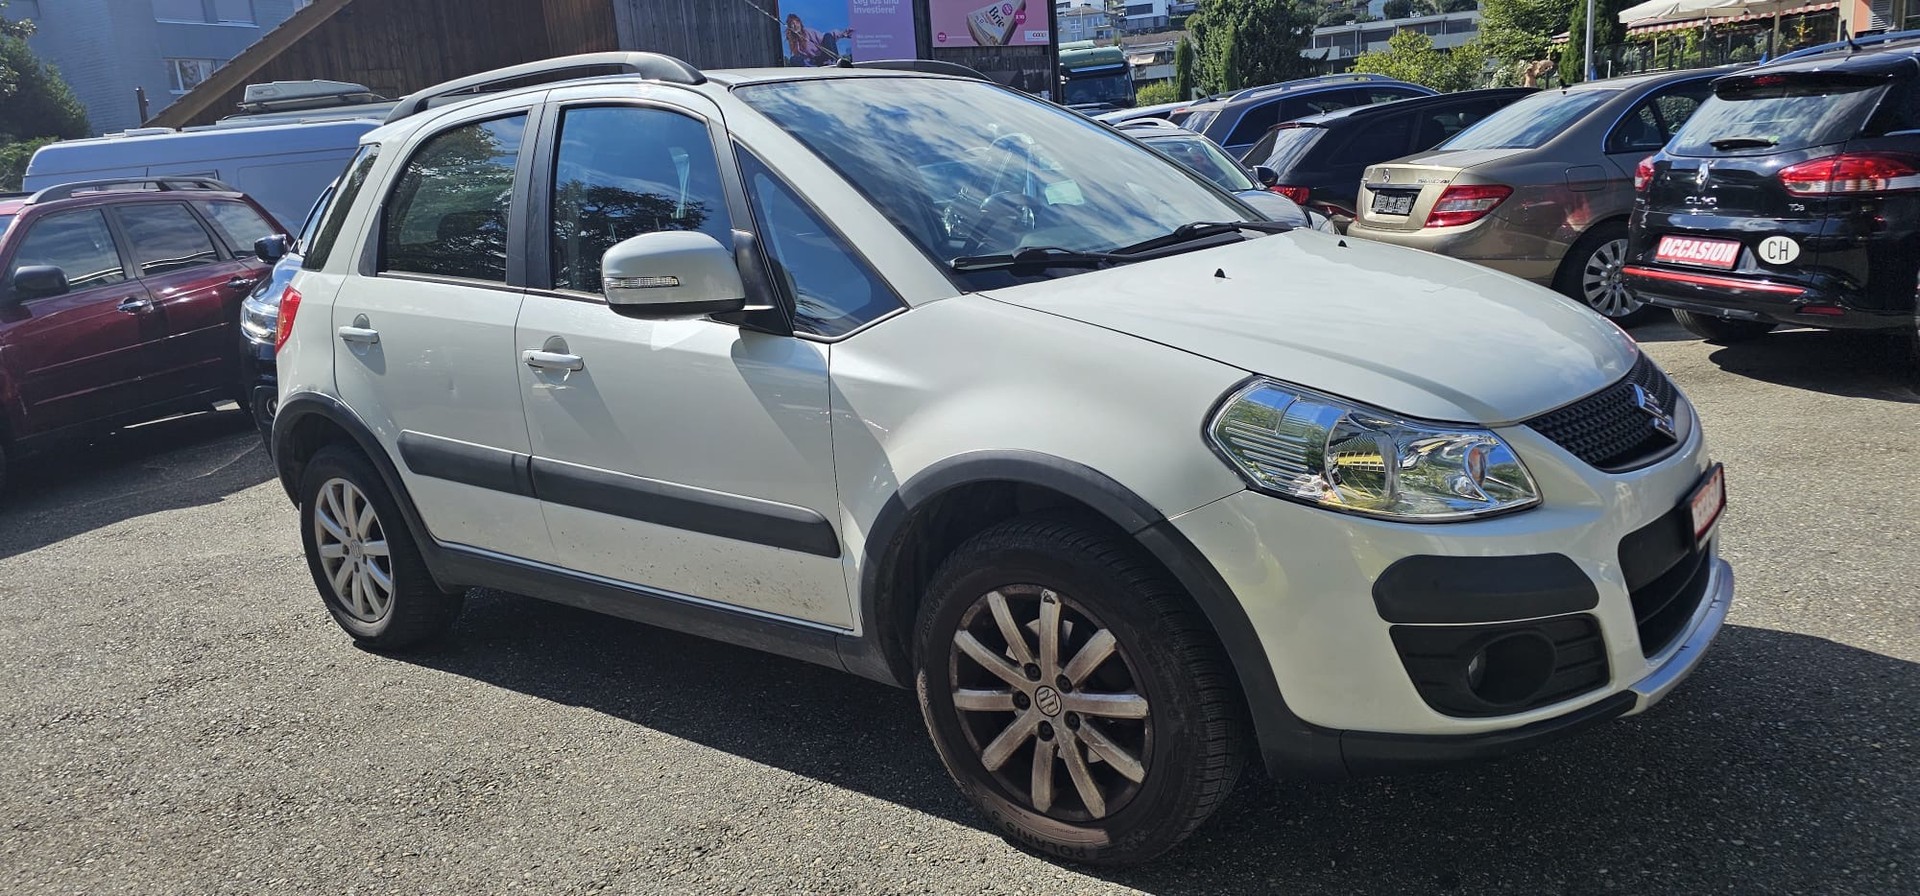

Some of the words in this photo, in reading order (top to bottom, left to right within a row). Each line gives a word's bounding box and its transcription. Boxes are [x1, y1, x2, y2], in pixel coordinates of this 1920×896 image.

[989, 6, 1005, 28] Brie
[1685, 196, 1717, 205] CLIO
[1658, 238, 1740, 262] OCCASION
[1767, 240, 1789, 260] CH
[1005, 821, 1087, 859] POLARIS
